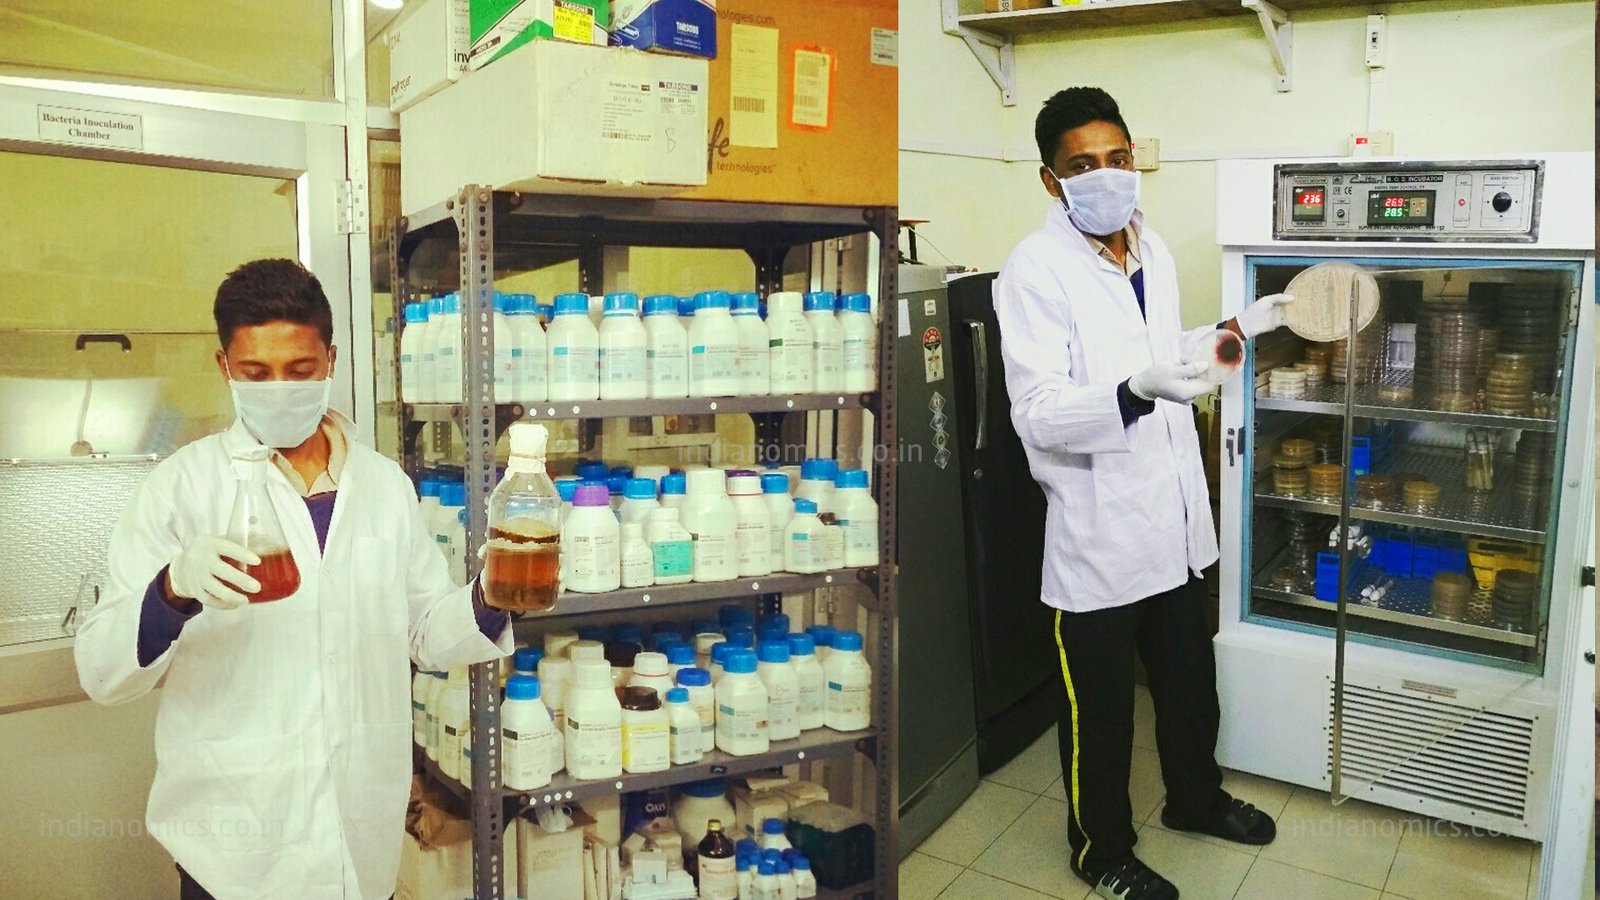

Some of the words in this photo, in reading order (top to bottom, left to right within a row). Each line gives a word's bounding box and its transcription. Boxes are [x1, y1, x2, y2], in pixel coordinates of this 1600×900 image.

[43, 112, 82, 126] Bacteria
[84, 117, 134, 131] Inoculation
[68, 128, 111, 140] Chamber
